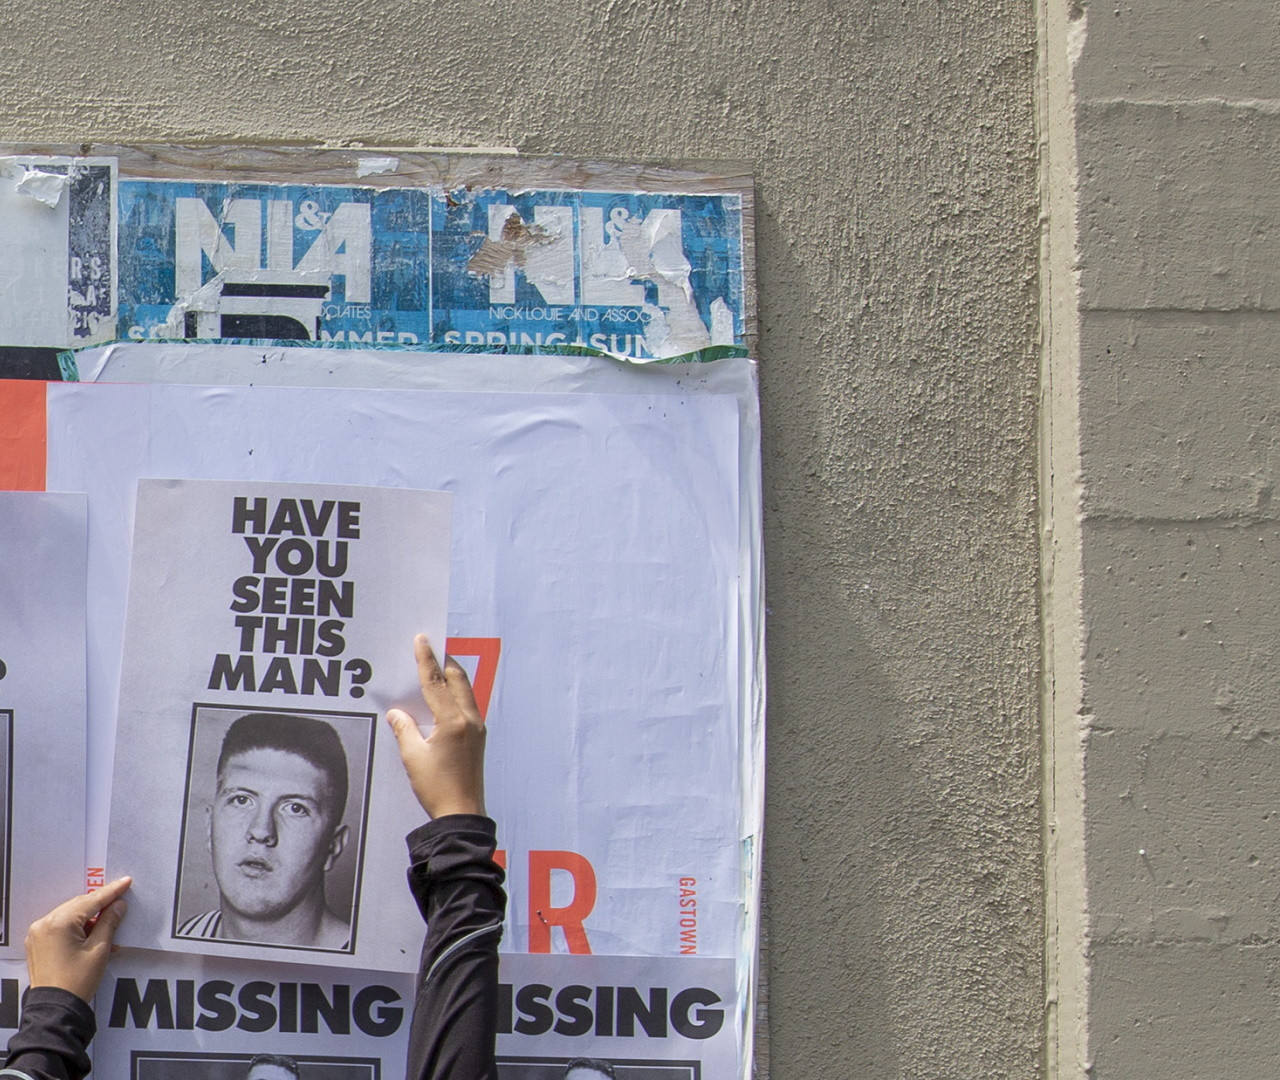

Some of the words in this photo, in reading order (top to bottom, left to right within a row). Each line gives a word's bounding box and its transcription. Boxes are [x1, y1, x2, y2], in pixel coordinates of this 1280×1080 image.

[489, 307, 524, 320] NICK
[526, 307, 563, 320] LOUIE
[567, 308, 599, 321] AND
[601, 308, 655, 322] ASSOC
[231, 496, 361, 540] HAVE
[243, 536, 349, 578] YOU
[229, 575, 355, 619] SEEN
[234, 615, 346, 658] THIS
[207, 653, 372, 699] MAN?
[492, 849, 598, 955] R
[678, 876, 698, 956] GASTOWN
[106, 977, 405, 1038] MISSING
[499, 983, 725, 1040] ISSING
